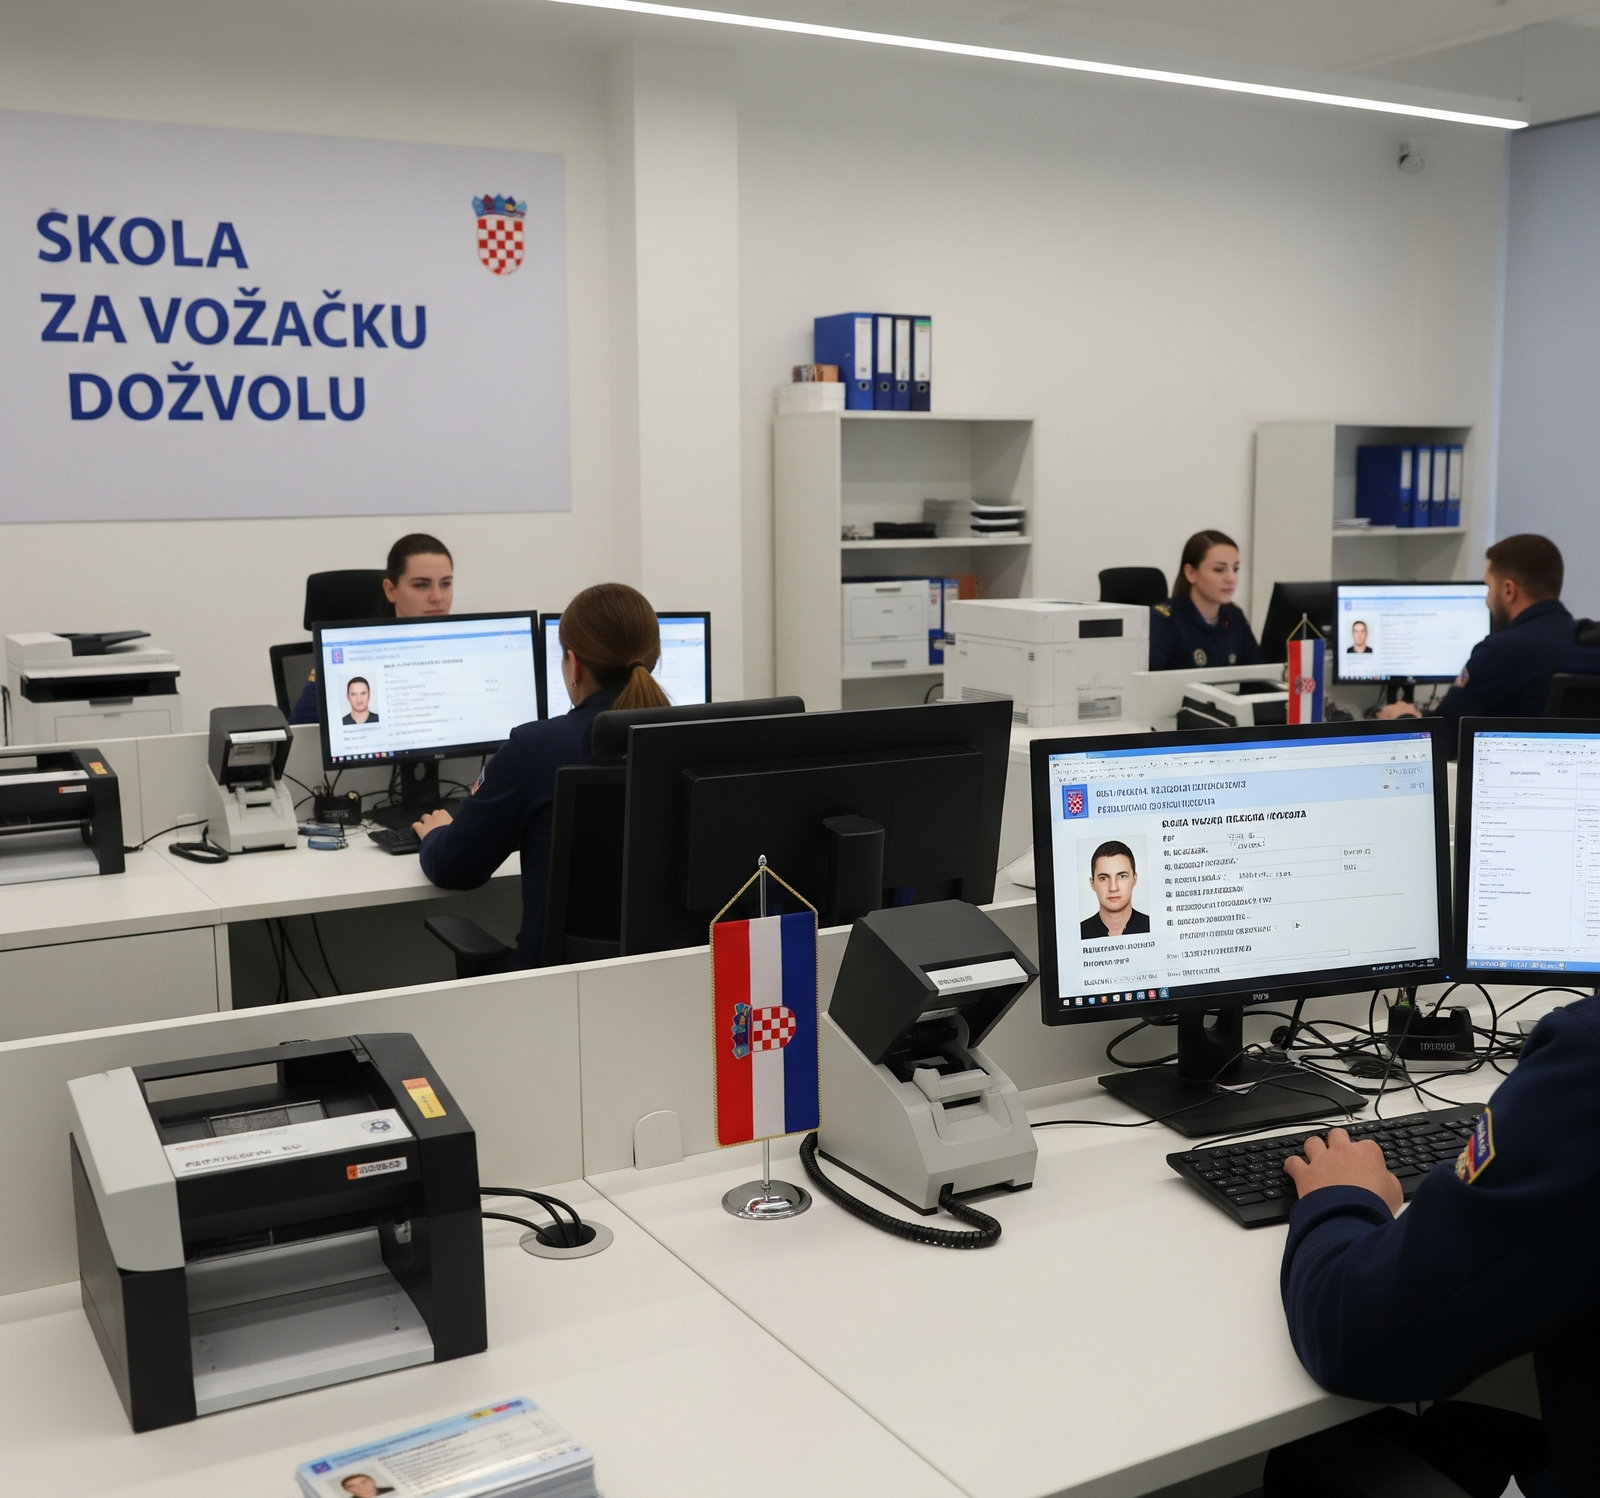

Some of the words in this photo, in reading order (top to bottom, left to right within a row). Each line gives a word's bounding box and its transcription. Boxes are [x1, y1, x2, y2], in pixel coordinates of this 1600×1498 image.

[41, 293, 126, 343] ZA
[140, 286, 427, 350] VOŽAČKU
[69, 361, 365, 421] DOŽVOLU
